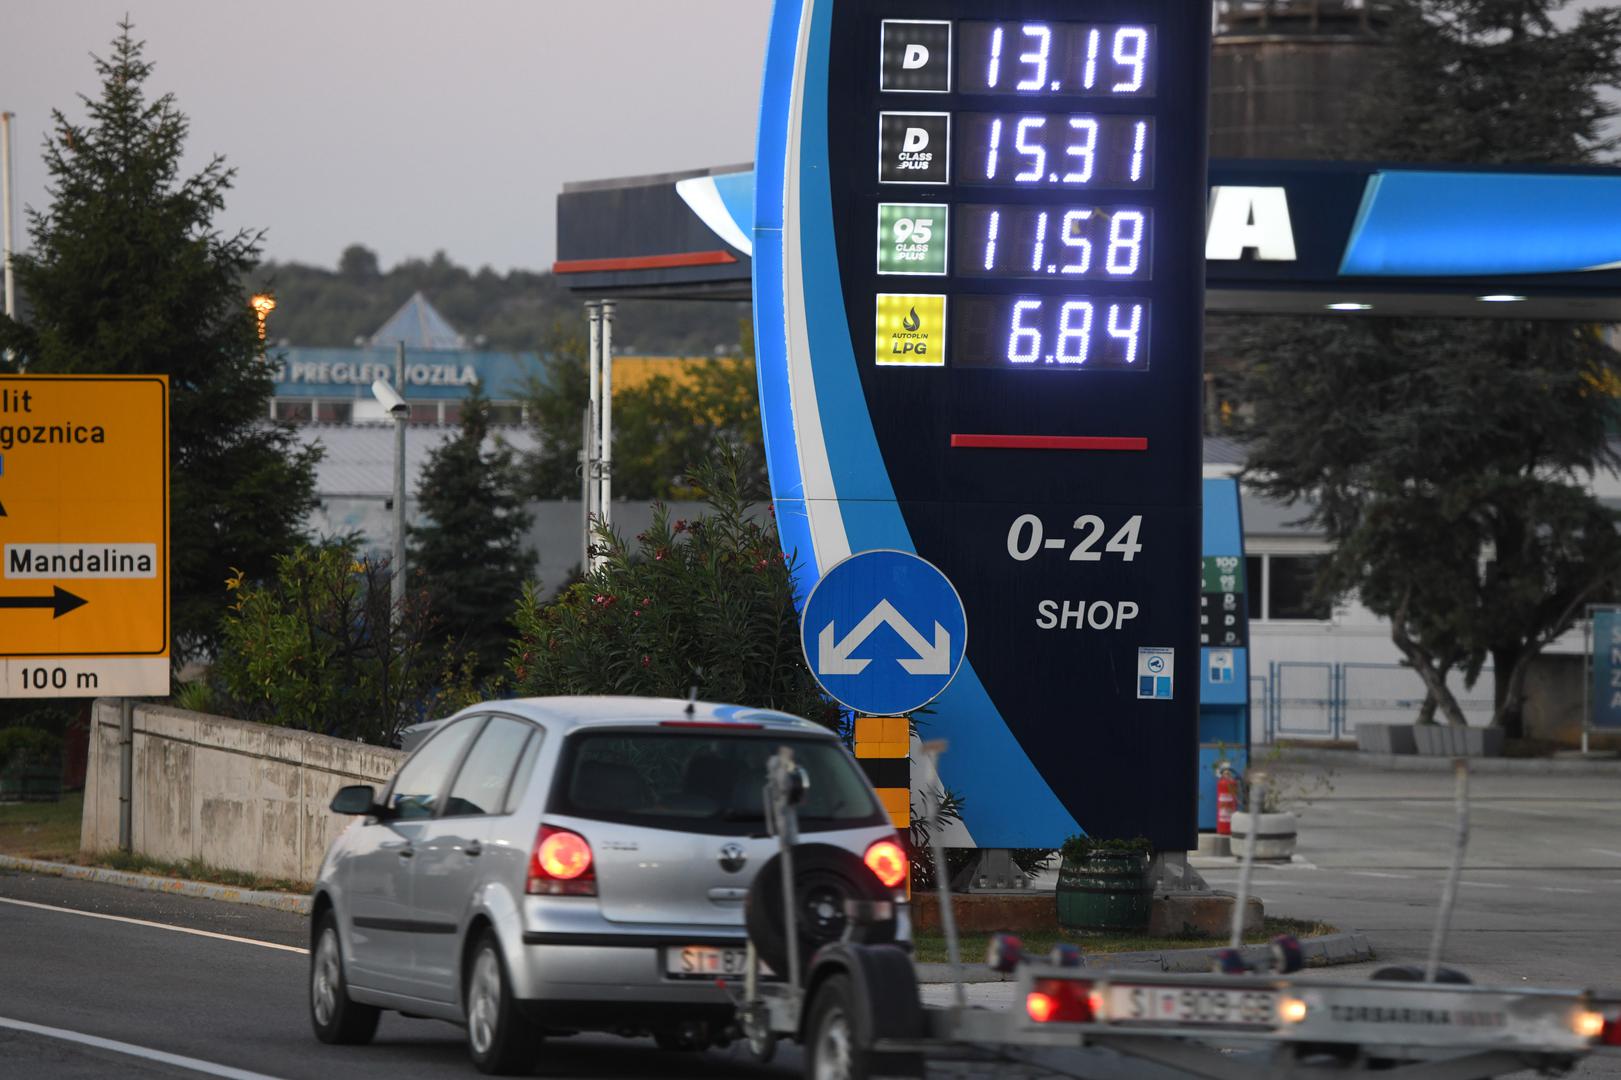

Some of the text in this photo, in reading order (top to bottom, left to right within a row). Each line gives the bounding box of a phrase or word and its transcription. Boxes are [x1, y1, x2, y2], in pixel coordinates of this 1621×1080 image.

[902, 44, 930, 69] D
[985, 25, 1148, 93] 13.19
[902, 127, 930, 153] D
[985, 117, 1146, 182] 15.31
[898, 152, 933, 161] CLASS
[898, 161, 929, 170] PLUS
[893, 218, 933, 244] 95
[983, 210, 1145, 275] 11.58
[895, 243, 929, 252] CLASS
[896, 252, 926, 261] PLUS
[1007, 300, 1143, 364] 6.84
[892, 342, 927, 355] LPG
[291, 361, 391, 384] PREGLED
[1007, 513, 1143, 561] 0-24
[9, 548, 152, 573] Mandalina
[1035, 599, 1139, 630] SHOP
[21, 667, 98, 690] 100 m
